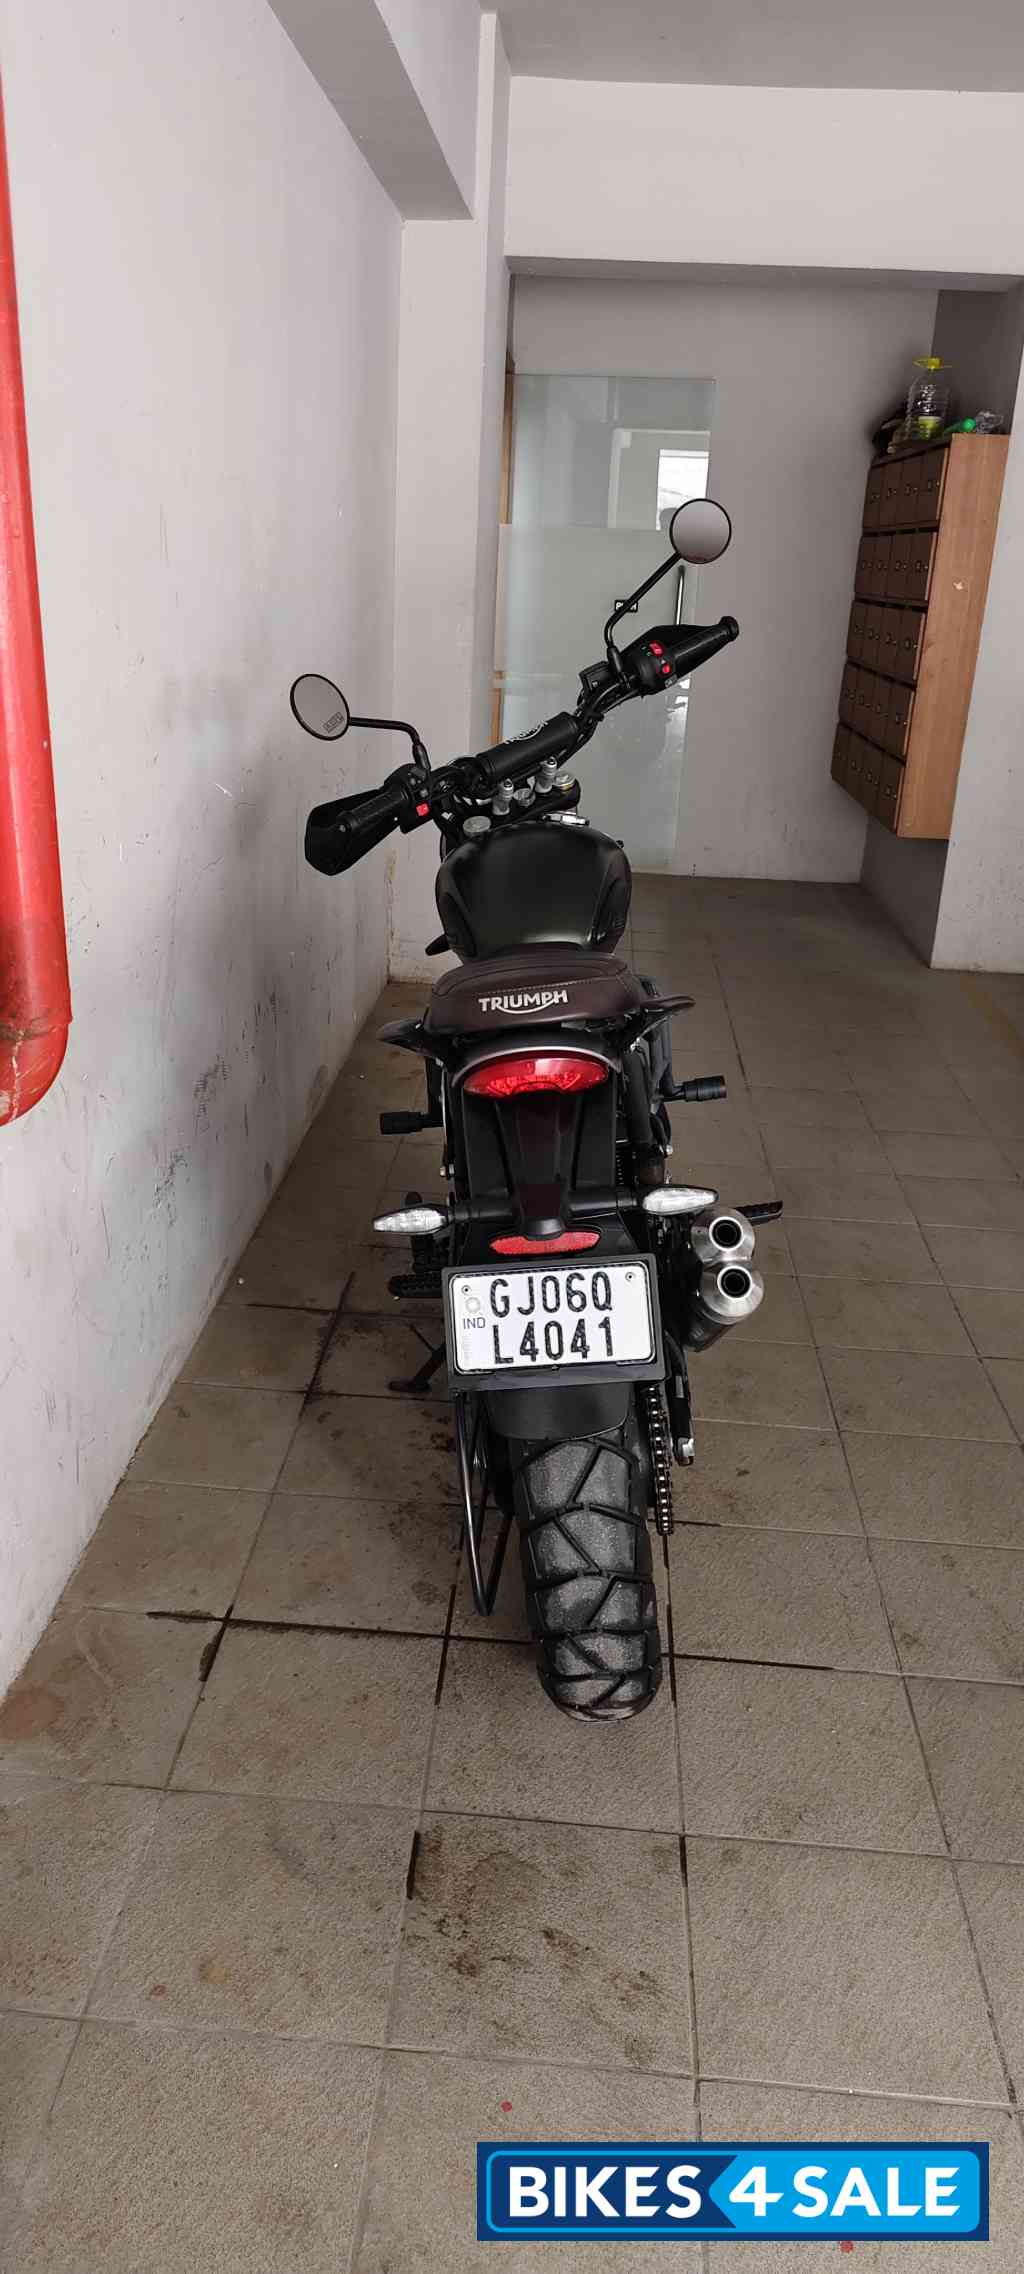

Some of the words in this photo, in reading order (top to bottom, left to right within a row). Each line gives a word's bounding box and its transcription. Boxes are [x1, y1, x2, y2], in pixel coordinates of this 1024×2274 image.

[478, 989, 569, 1015] TRIUMPH
[489, 1271, 613, 1318] GJ06Q
[463, 1316, 486, 1330] IND
[492, 1316, 614, 1365] L4041
